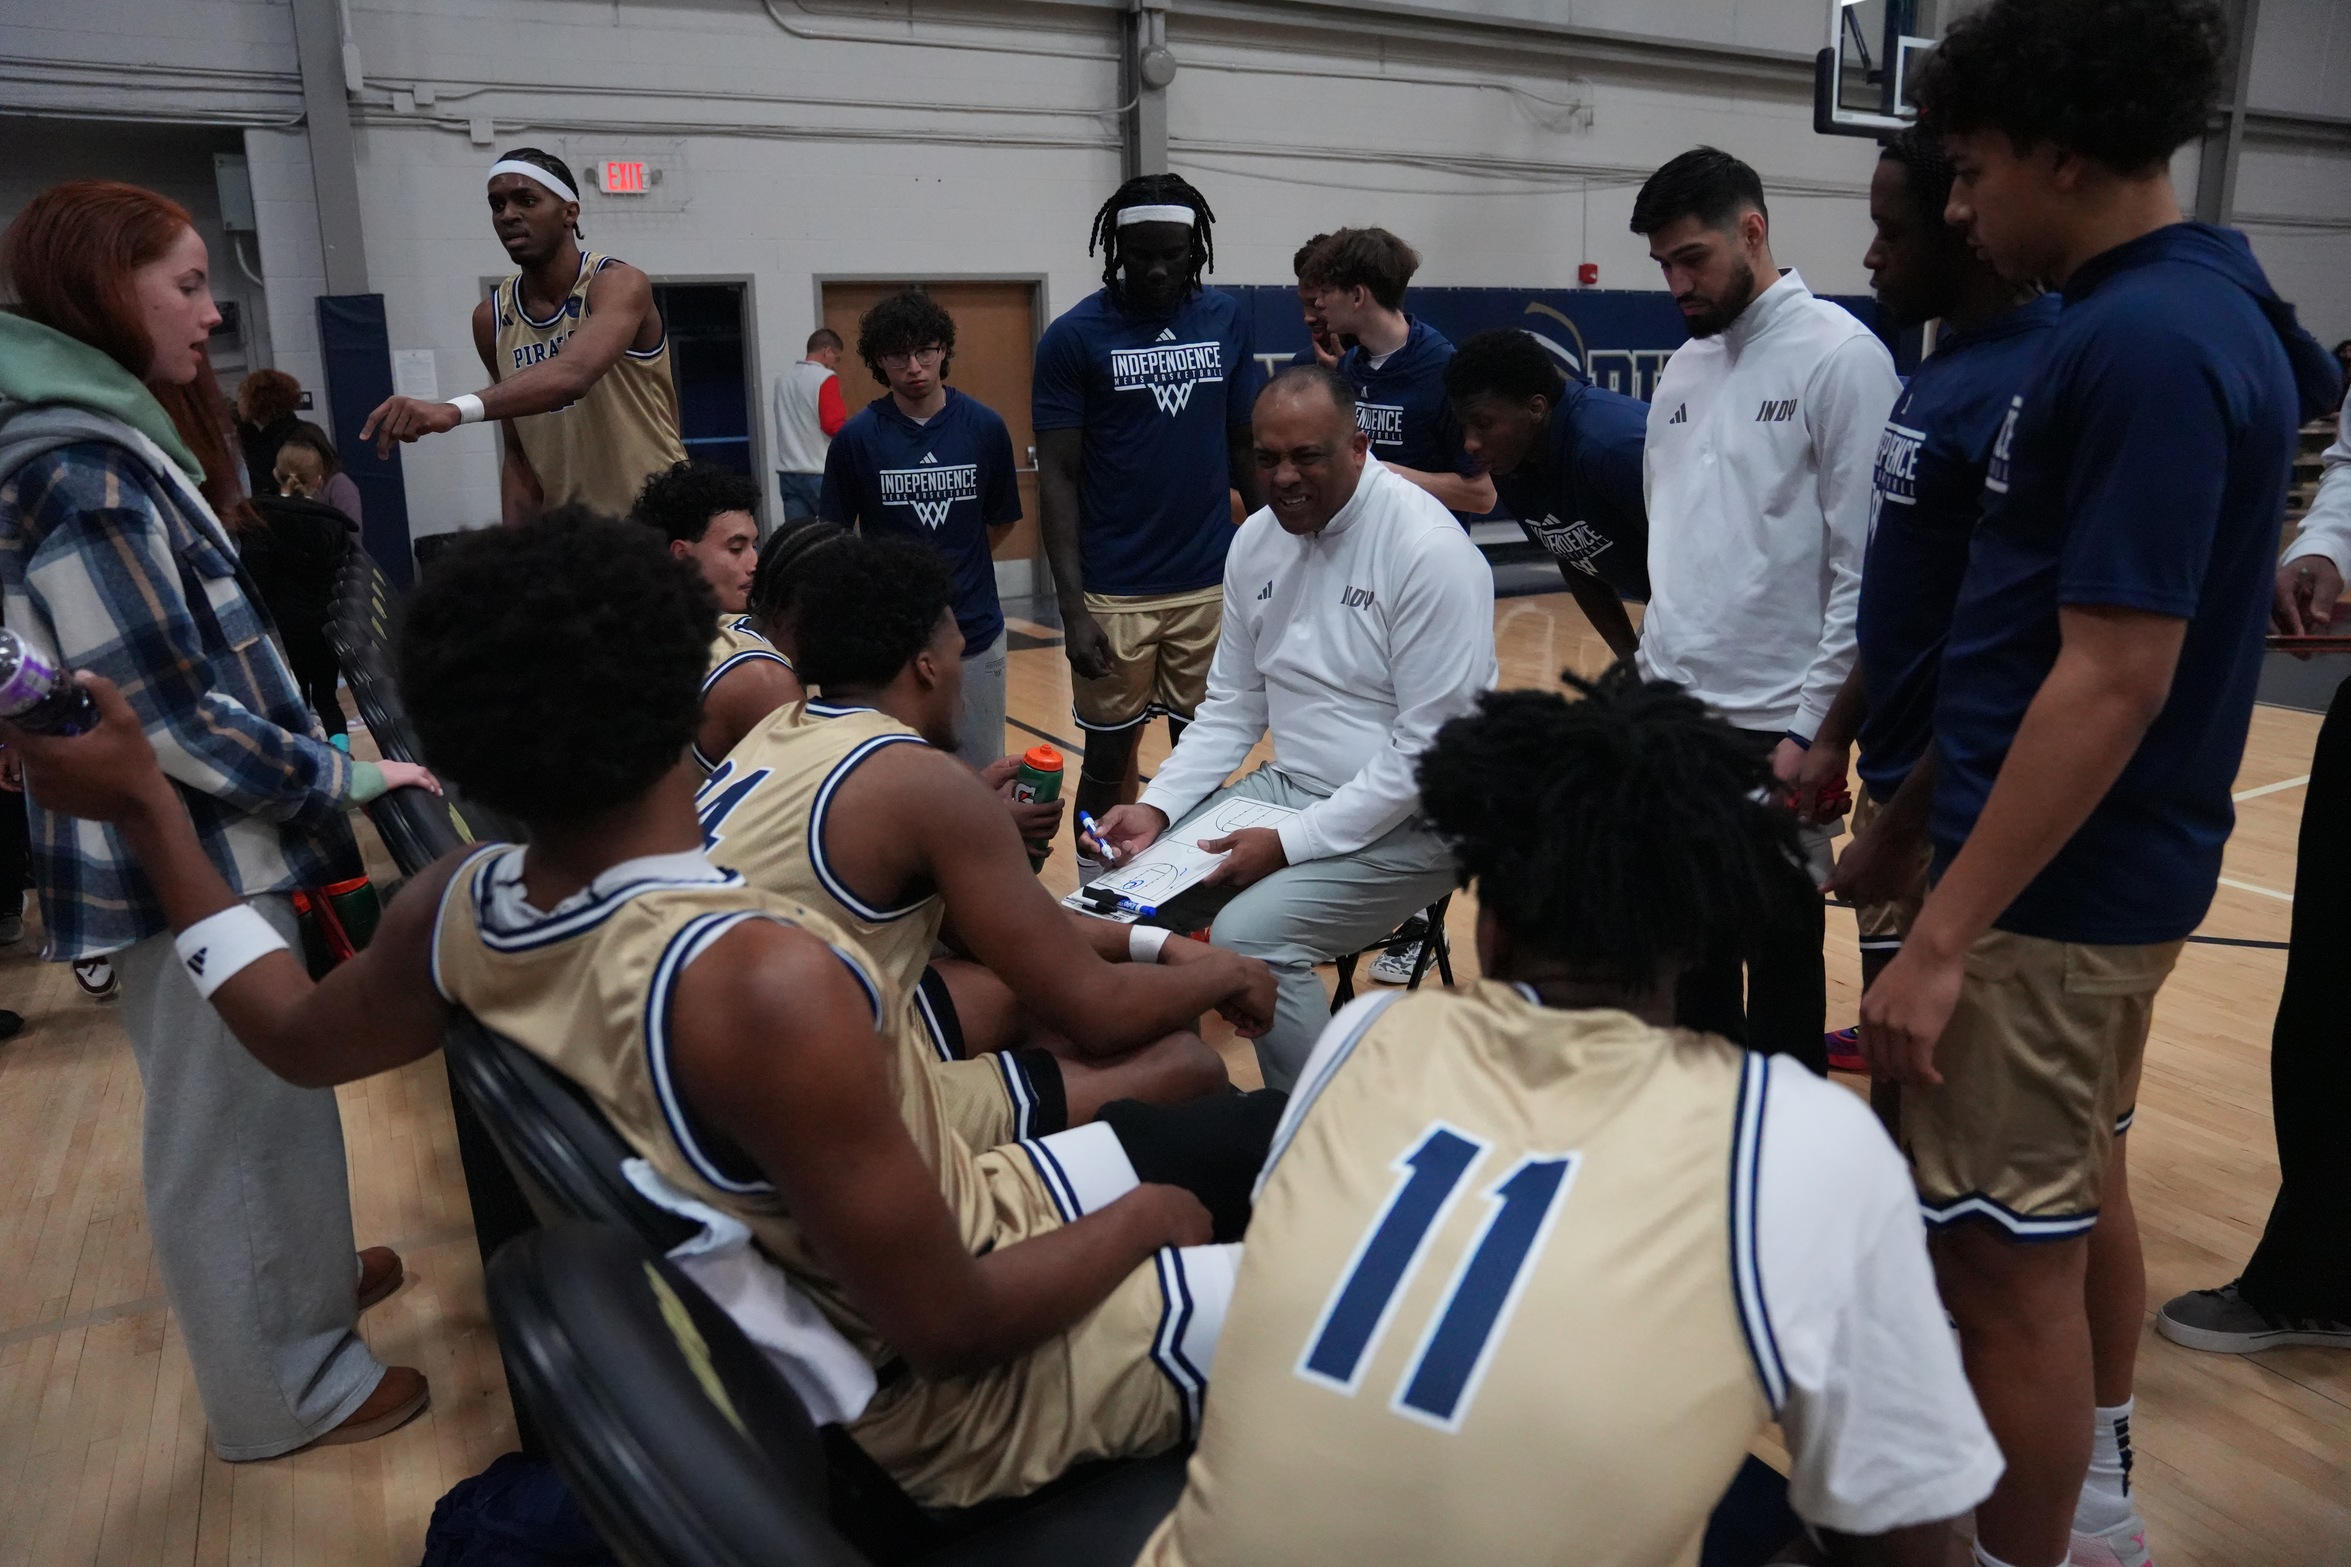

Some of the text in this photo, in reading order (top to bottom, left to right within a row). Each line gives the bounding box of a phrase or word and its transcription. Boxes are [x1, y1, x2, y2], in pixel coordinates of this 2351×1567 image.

[607, 162, 643, 191] EXIT
[1112, 347, 1222, 377] INDEPENDENCE
[1114, 369, 1223, 386] MENS BASKETBALL
[1755, 398, 1798, 421] INDY
[880, 469, 977, 494] INDEPENDENCE
[882, 488, 977, 501] MENS BASKETBALL
[1293, 1117, 1583, 1435] 11
